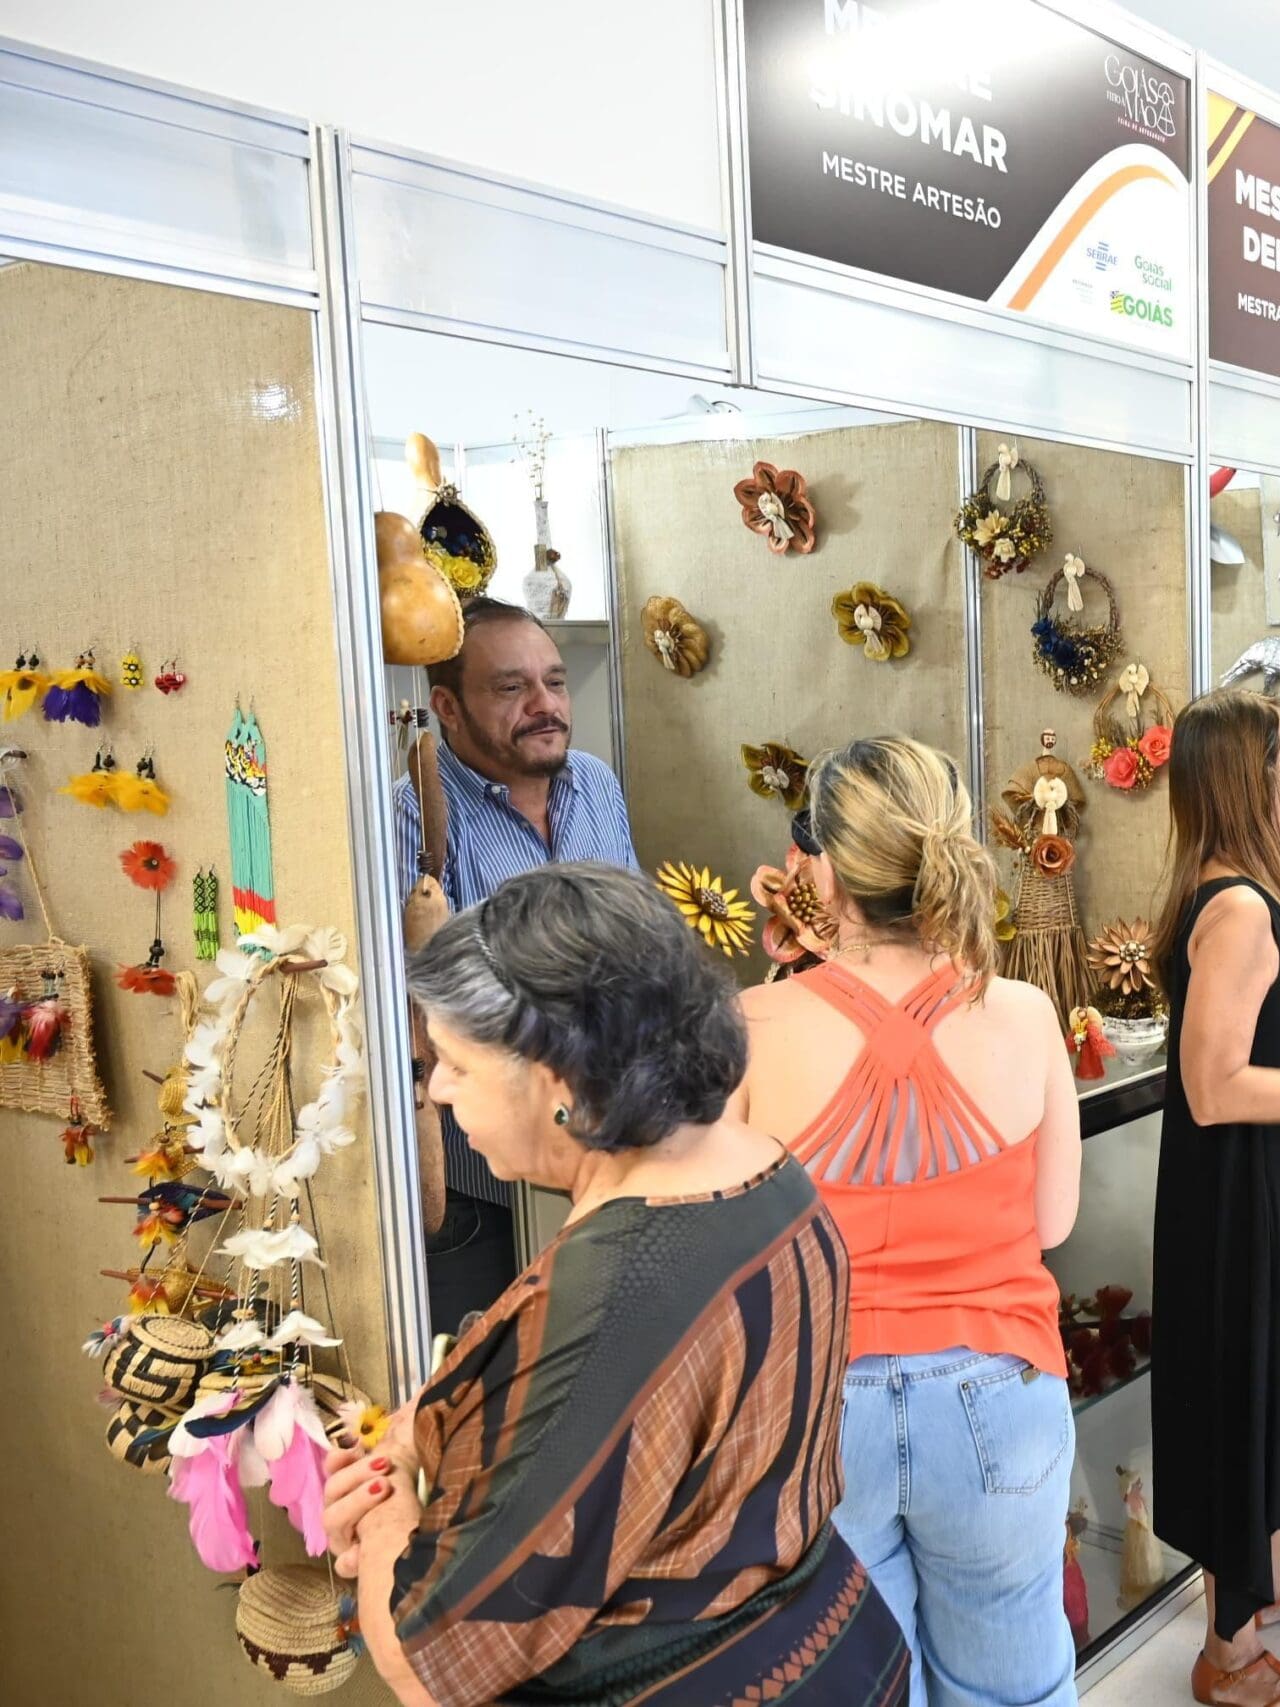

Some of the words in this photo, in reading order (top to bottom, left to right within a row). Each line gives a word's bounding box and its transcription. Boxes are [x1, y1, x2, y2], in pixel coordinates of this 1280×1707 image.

[822, 151, 906, 199] MESTRE
[912, 182, 1001, 229] ARTESÃO
[1086, 247, 1118, 266] SEBRAE
